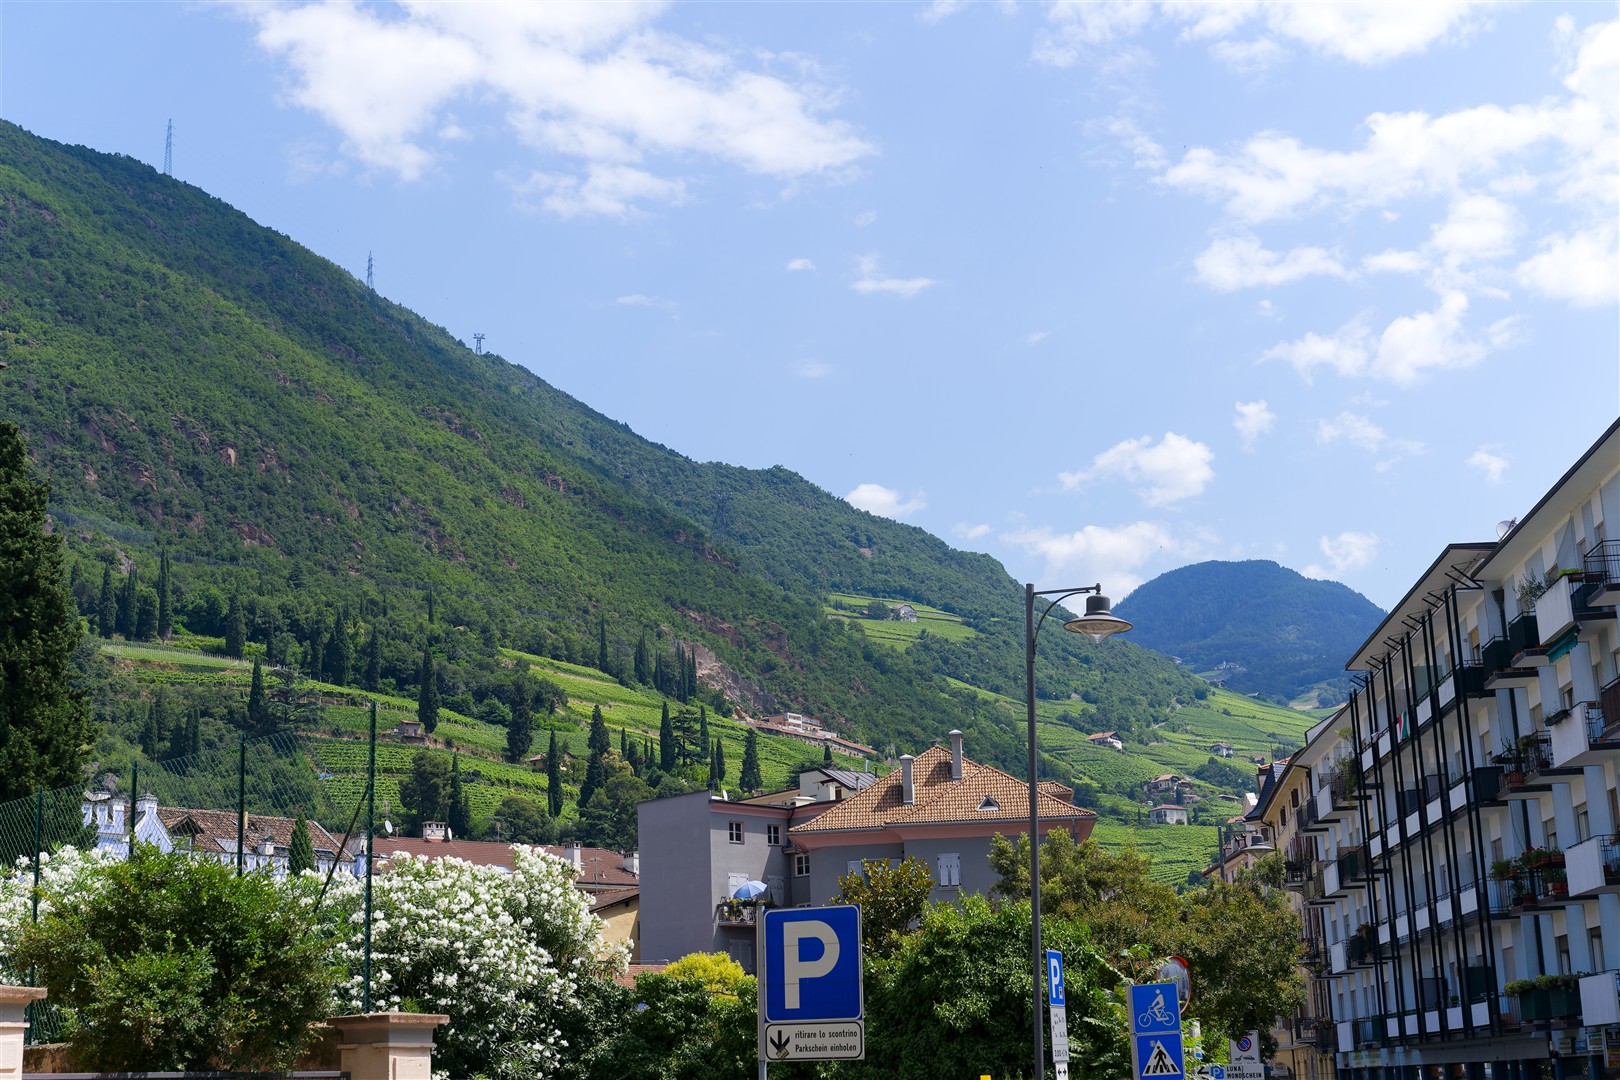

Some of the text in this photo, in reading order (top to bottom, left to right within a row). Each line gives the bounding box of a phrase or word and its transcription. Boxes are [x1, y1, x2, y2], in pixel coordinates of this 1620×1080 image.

[783, 920, 840, 1009] P
[1050, 958, 1060, 998] P
[795, 1029, 858, 1039] ritirare lo scontrino
[795, 1043, 857, 1053] Parkschein einholen
